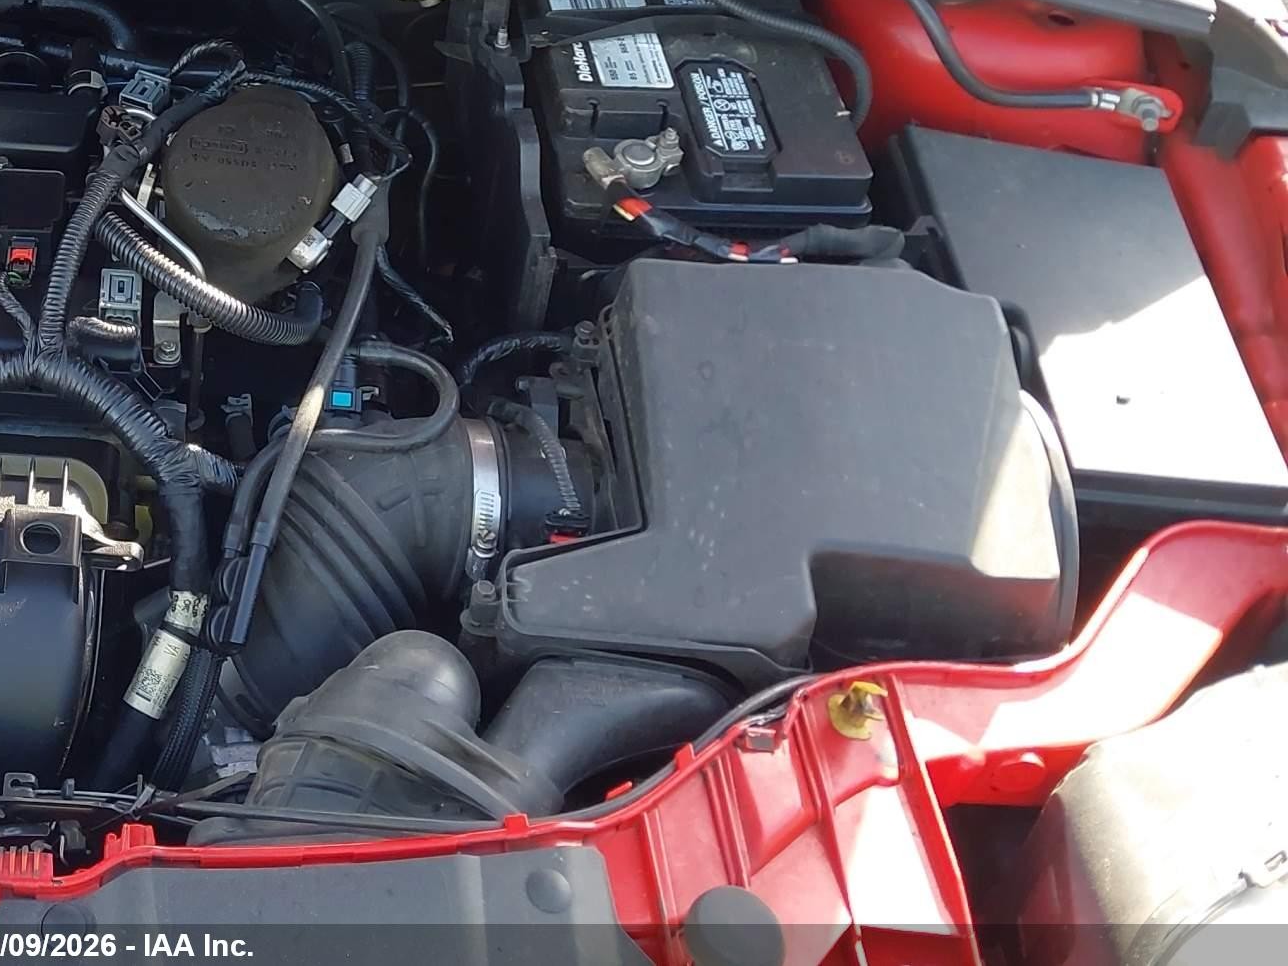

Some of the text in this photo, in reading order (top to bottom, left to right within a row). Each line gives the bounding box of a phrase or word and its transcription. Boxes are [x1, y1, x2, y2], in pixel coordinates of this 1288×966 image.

[690, 72, 708, 101] POISON
[702, 107, 722, 139] DANGER
[164, 643, 180, 658] VA
